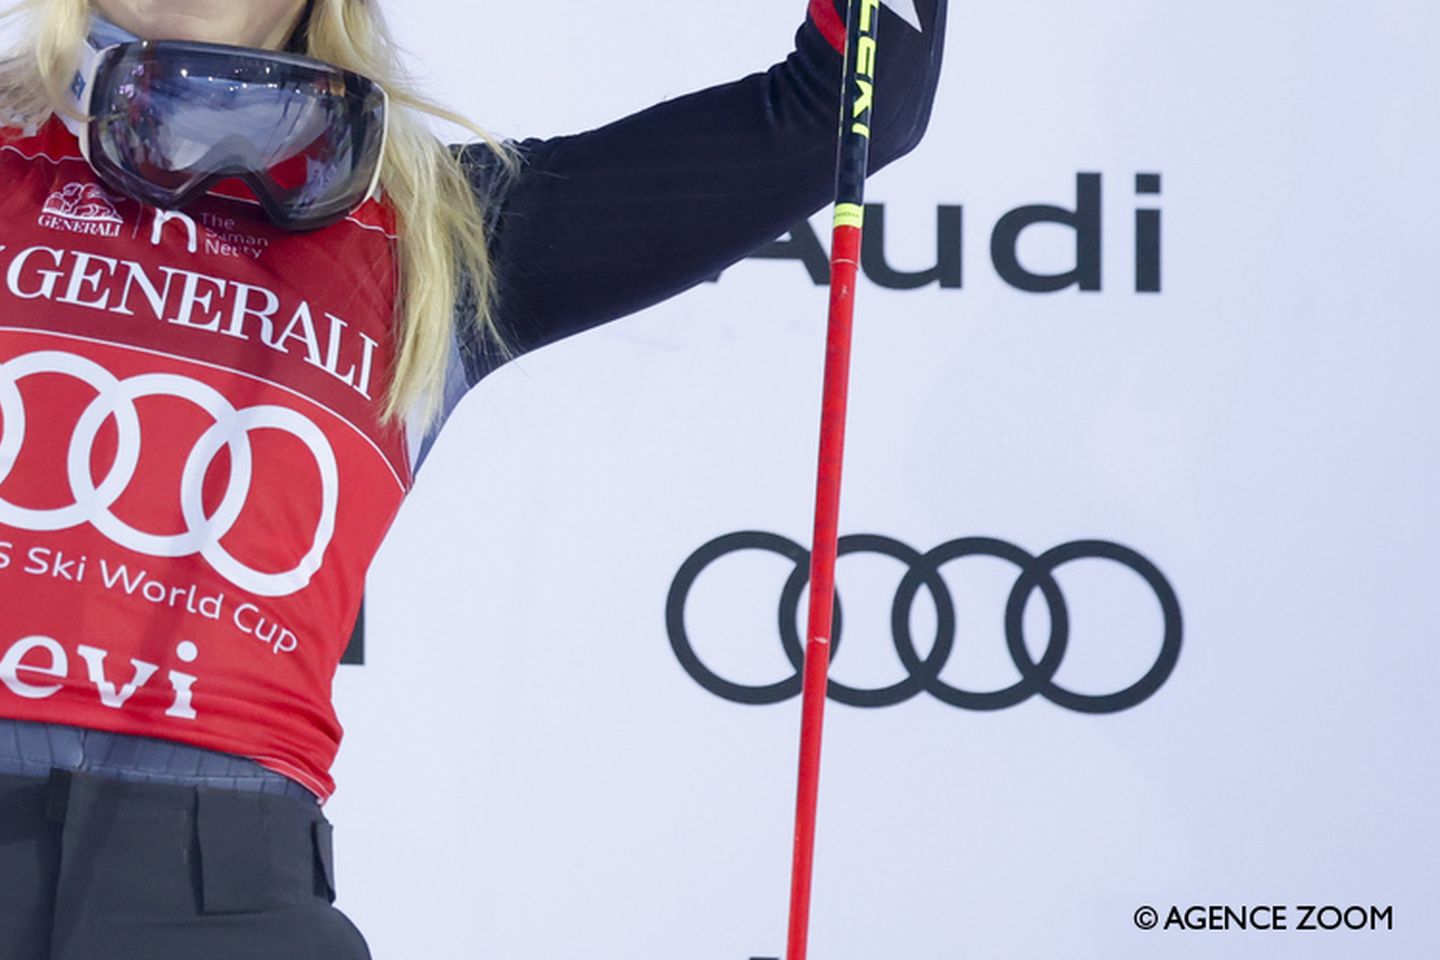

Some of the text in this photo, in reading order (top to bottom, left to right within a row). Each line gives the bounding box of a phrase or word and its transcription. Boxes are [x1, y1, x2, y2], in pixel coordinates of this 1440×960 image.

[37, 214, 122, 238] GENERALI
[6, 245, 379, 402] GENERALI
[23, 546, 87, 583] Ski
[99, 558, 225, 621] World
[233, 602, 300, 655] Cup
